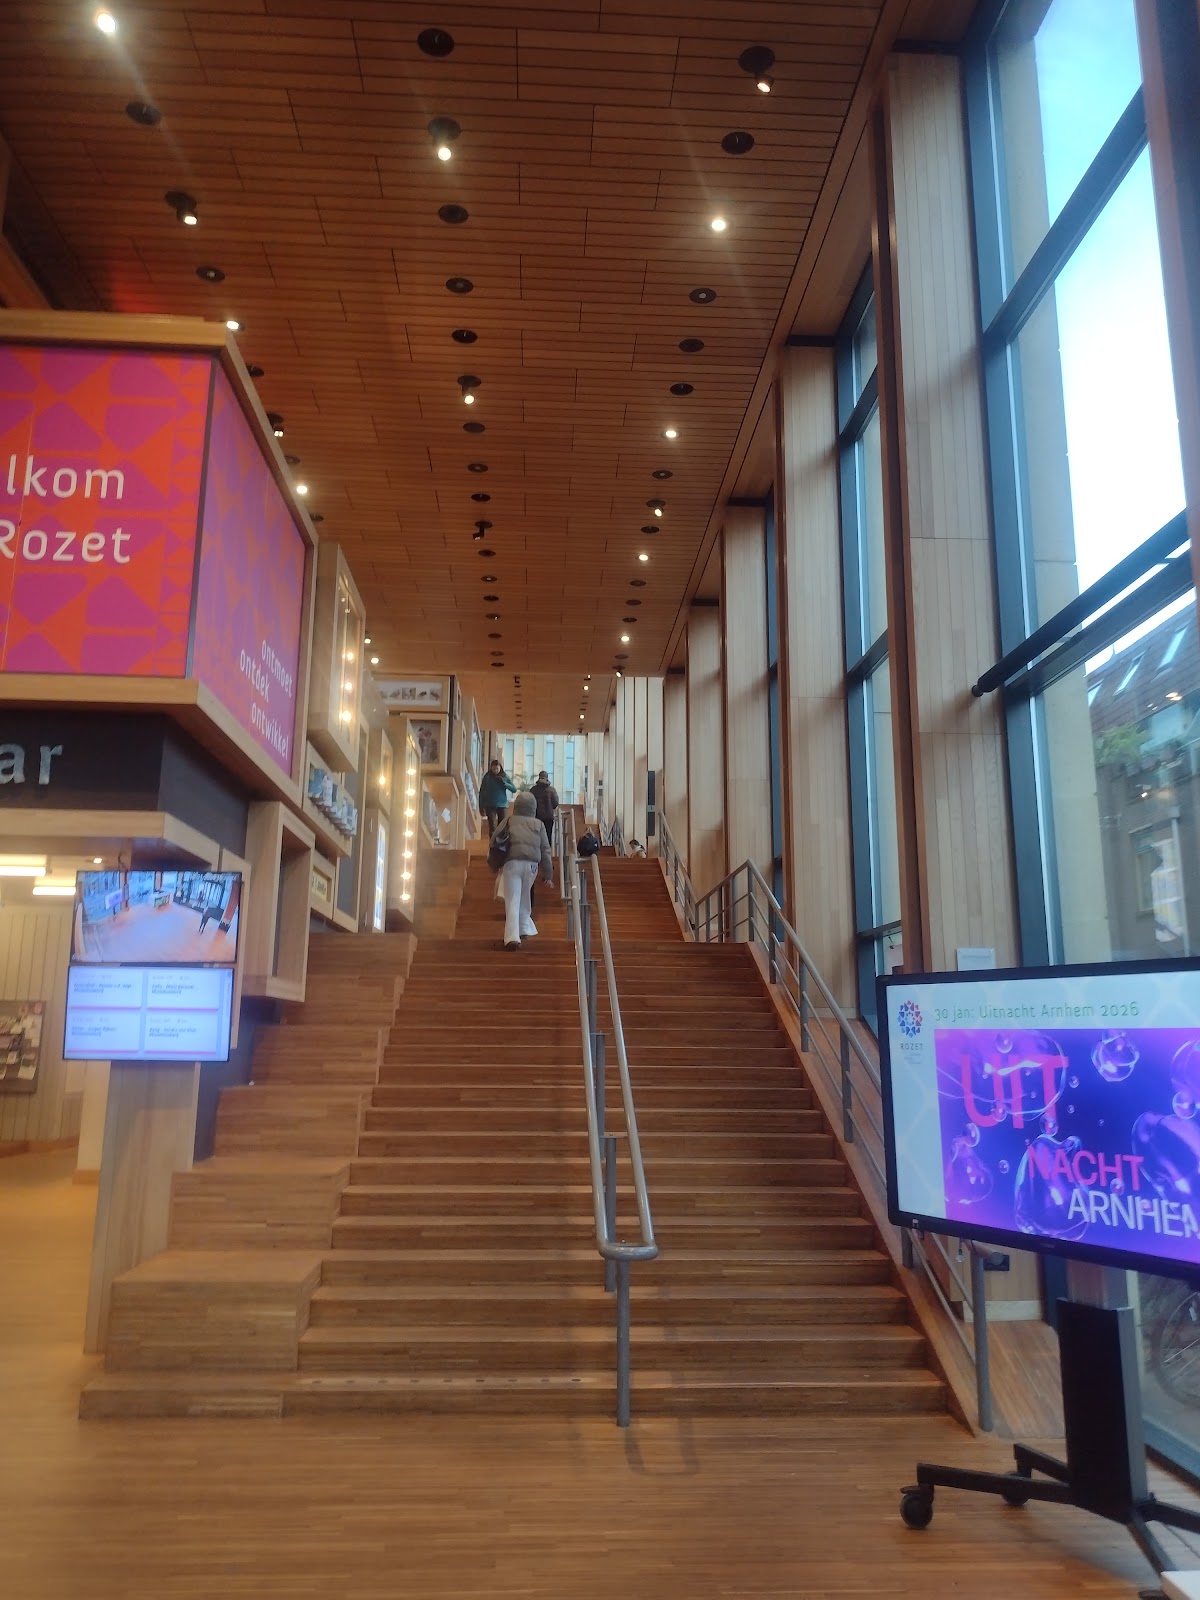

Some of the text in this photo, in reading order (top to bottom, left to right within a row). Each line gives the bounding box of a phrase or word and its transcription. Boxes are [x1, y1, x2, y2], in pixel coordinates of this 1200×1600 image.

[7, 454, 125, 500] lkom
[0, 519, 131, 563] Rozet
[240, 649, 270, 703] ontdek
[262, 640, 293, 698] ontmoet
[252, 702, 289, 760] ontwikkel
[934, 1001, 1140, 1022] 30 jan: Uitnacht Arnhem 2026
[900, 1042, 923, 1051] ROZET
[961, 1054, 1069, 1135] UIT
[1027, 1146, 1145, 1192] NACHT
